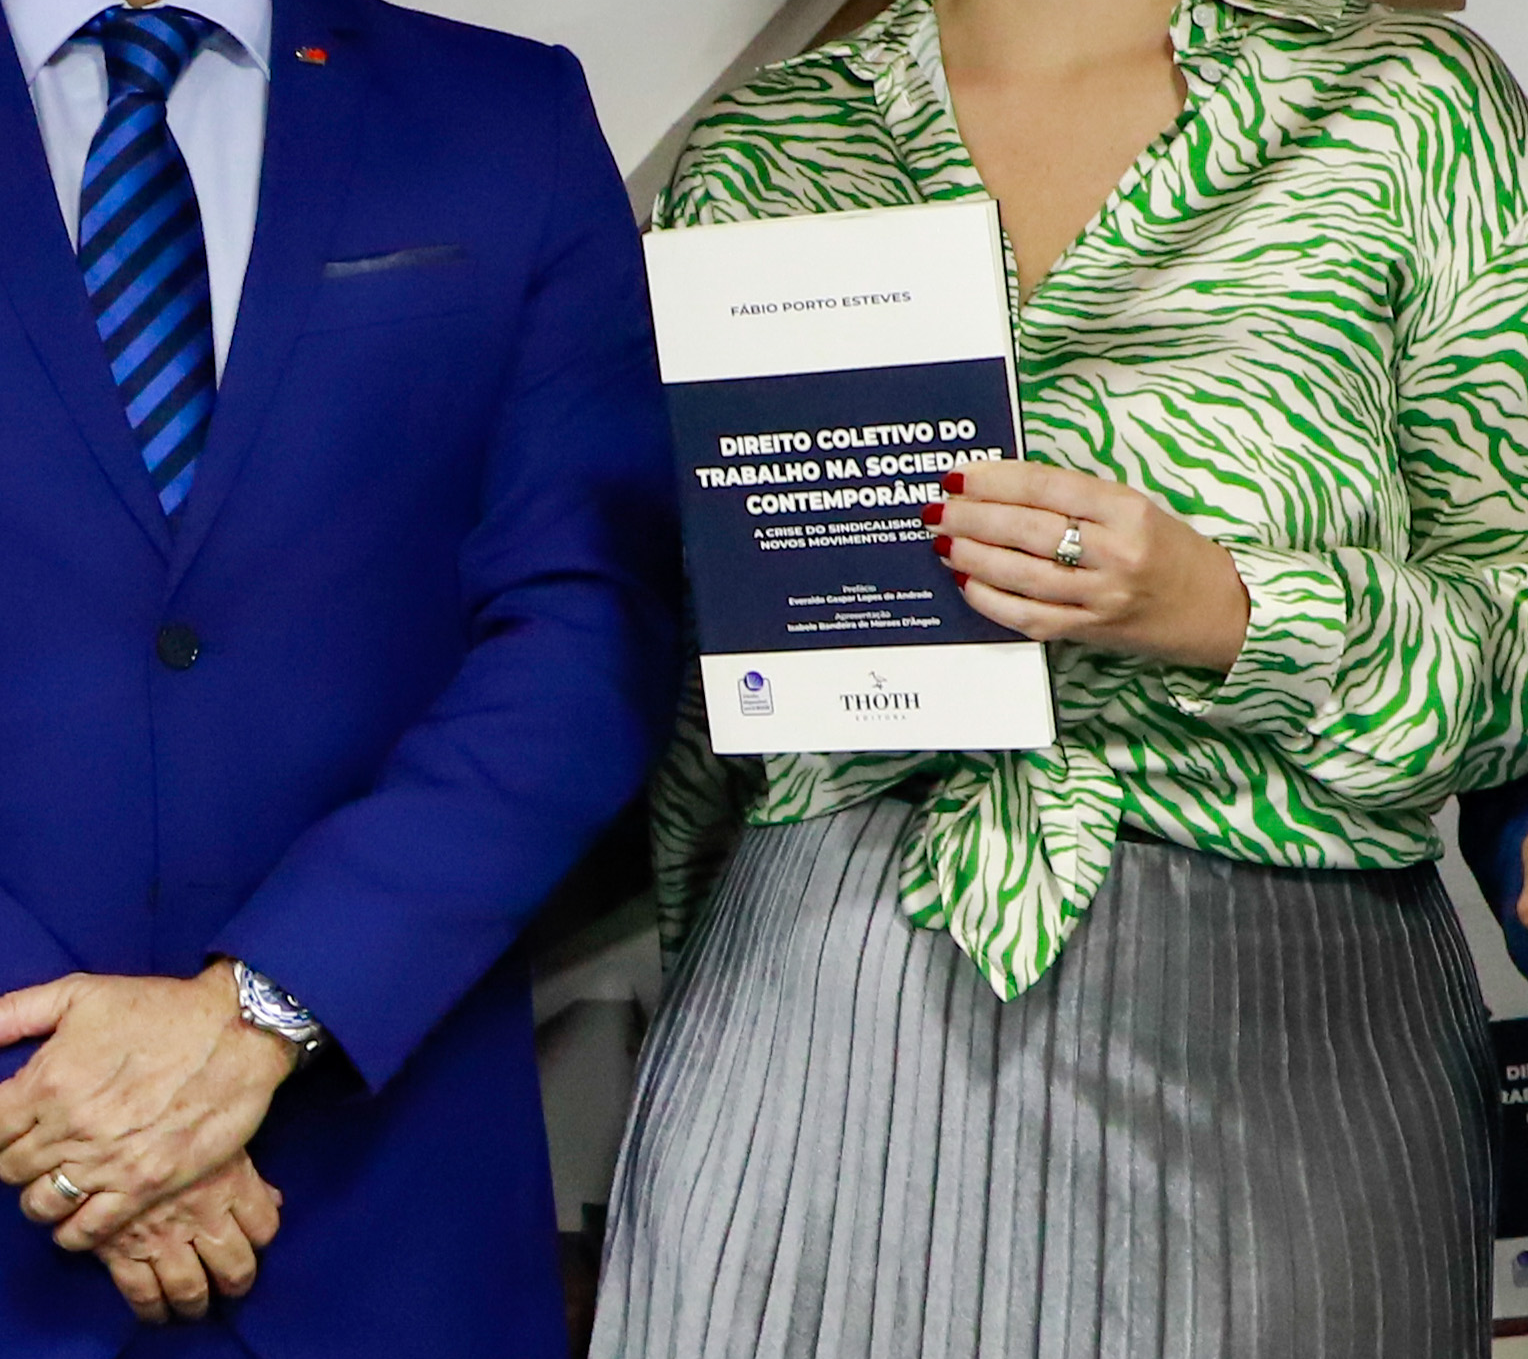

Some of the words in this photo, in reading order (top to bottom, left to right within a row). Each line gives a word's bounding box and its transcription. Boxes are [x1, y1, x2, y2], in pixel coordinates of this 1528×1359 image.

[730, 303, 778, 317] FÁBIO
[782, 298, 837, 312] PORTO
[841, 291, 911, 307] ESTEVES
[719, 431, 812, 457] DIREITO
[816, 422, 934, 450] COLETIVO
[938, 419, 976, 441] DO
[695, 460, 821, 488] TRABALHO
[824, 458, 863, 480] NA
[746, 479, 948, 515] CONTEMPORÂNE
[753, 528, 764, 538] A
[765, 525, 803, 538] CRISE
[804, 524, 826, 536] DO
[827, 518, 923, 534] SINDICALISMO
[759, 537, 806, 550] NOVOS
[807, 531, 897, 547] MOVIMENTOS
[898, 528, 937, 542] SOCIA
[840, 692, 919, 711] THOTH
